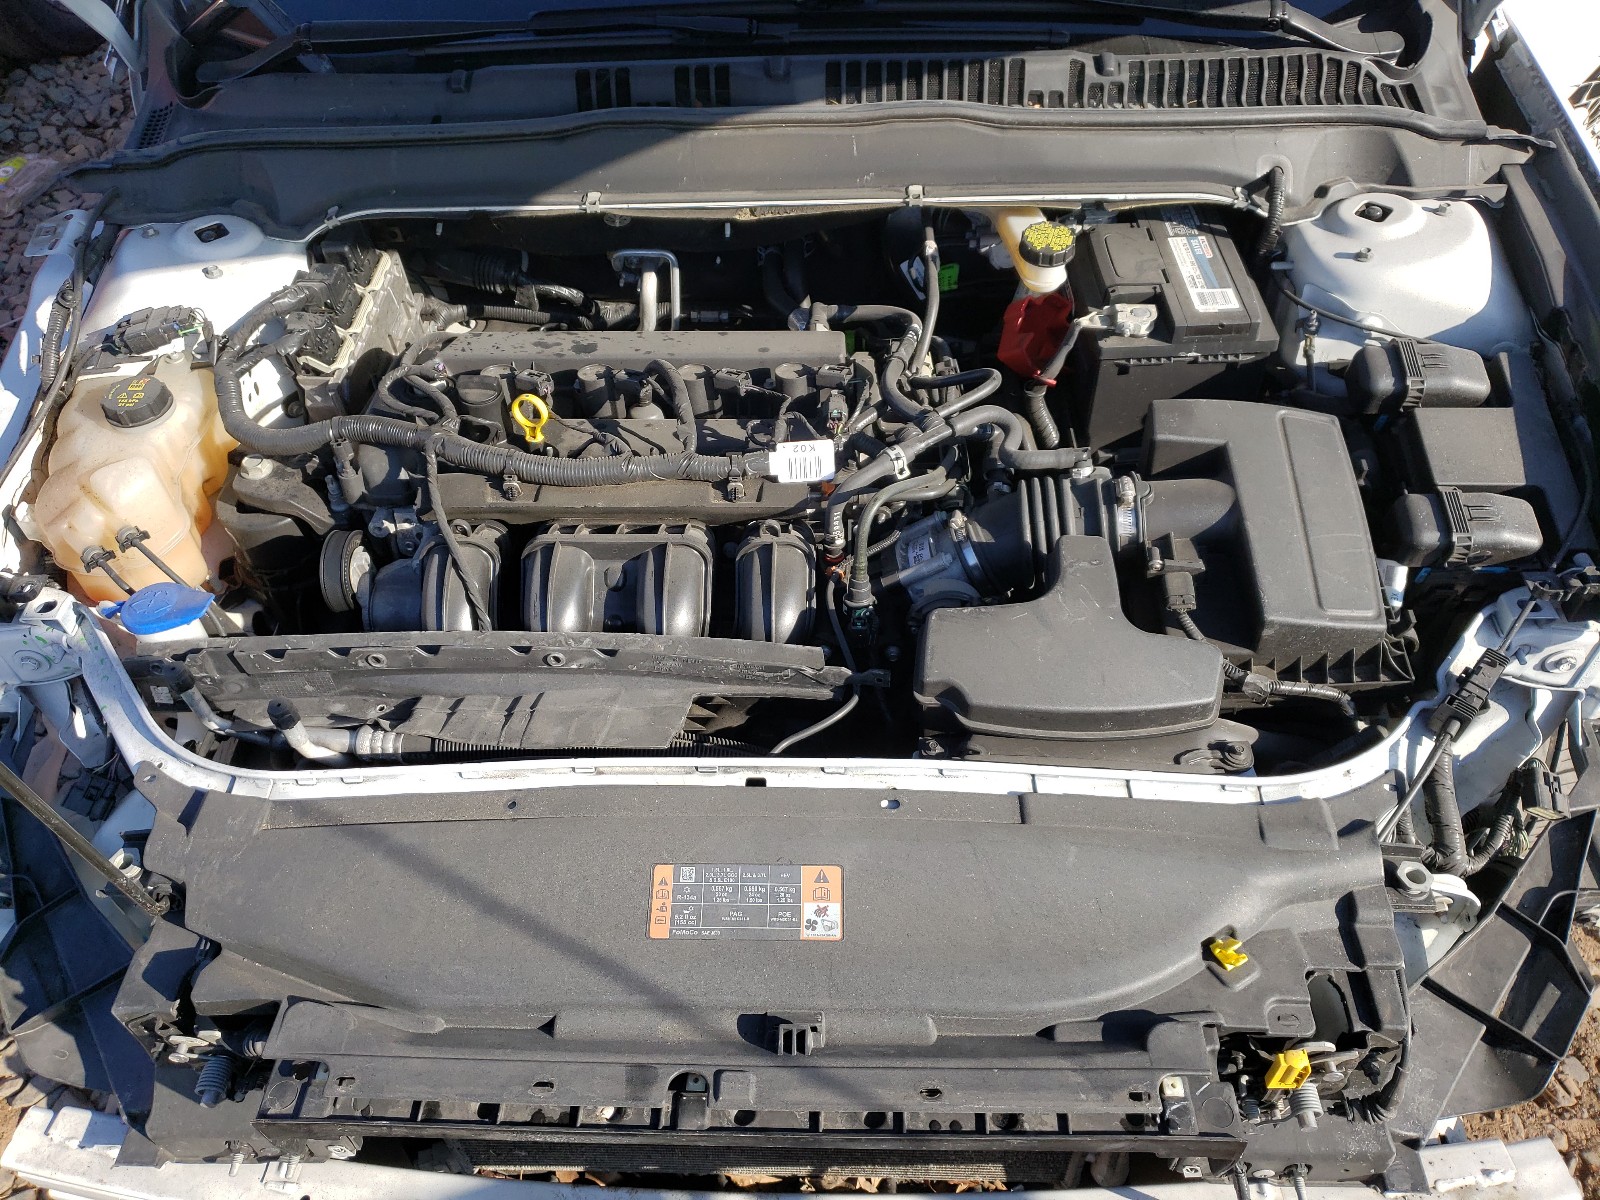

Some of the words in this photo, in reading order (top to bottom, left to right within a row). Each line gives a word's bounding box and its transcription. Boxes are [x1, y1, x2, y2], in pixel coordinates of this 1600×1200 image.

[792, 444, 816, 453] K02
[725, 885, 733, 893] kg
[758, 885, 766, 893] kg
